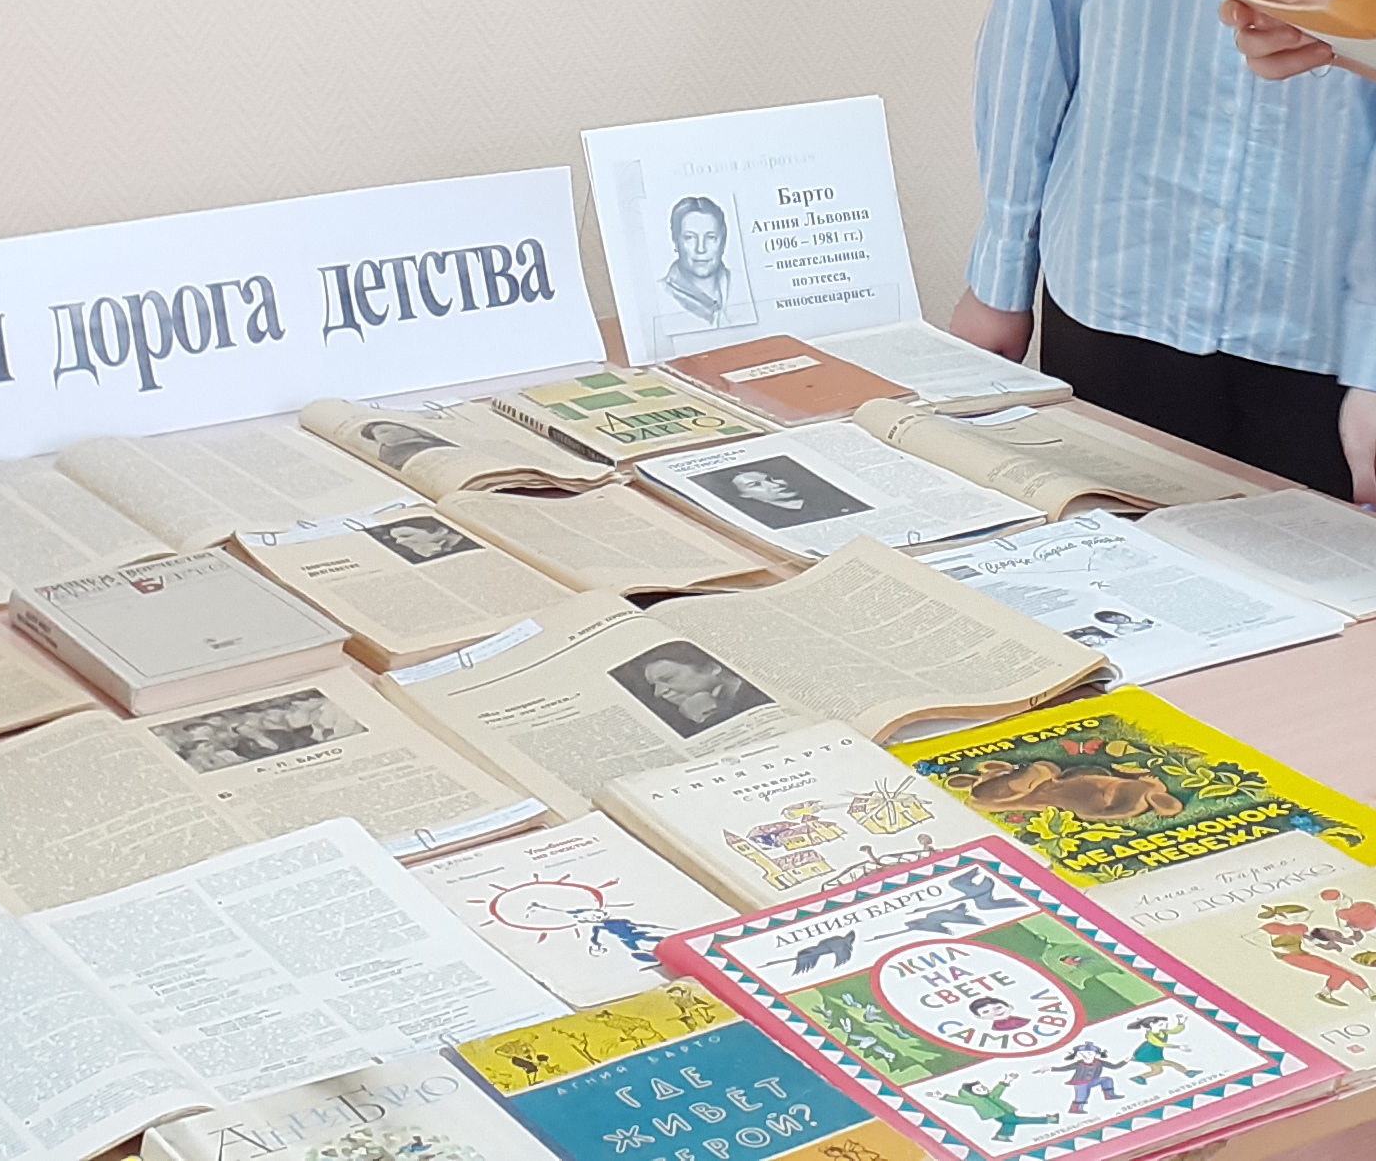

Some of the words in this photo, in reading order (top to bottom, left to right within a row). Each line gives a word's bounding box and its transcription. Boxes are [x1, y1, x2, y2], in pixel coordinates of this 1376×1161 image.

[777, 186, 835, 208] Барто
[750, 216, 800, 234] Агния
[803, 208, 870, 228] Львовна
[763, 235, 798, 254] (1906
[812, 231, 840, 247] 1981
[775, 249, 871, 271] писательница,
[775, 287, 876, 310] киносценарист.
[791, 271, 852, 288] поэтесса,
[47, 274, 286, 393] дорога
[317, 236, 556, 347] детства
[596, 415, 727, 445] БАРТО
[601, 405, 708, 433] АГНИЯ
[937, 737, 1015, 765] АГНИЯ
[1021, 716, 1101, 745] БАРТО
[650, 770, 748, 800] АГНИЯ
[761, 737, 853, 771] БАРТО
[1062, 802, 1294, 873] МЕДВЕЖОНОК-
[1137, 824, 1280, 867] НЕВЕЖА
[774, 909, 863, 950] АГНИЯ
[867, 883, 945, 930] БАРТО
[1134, 884, 1206, 910] Агния
[887, 946, 971, 978] ЖИЛ
[920, 965, 975, 988] НА
[919, 970, 1017, 1009] СВЕТЕ
[937, 988, 1069, 1050] САМОСВАЛ
[555, 1064, 629, 1097] АГНИЯ
[647, 1034, 722, 1065] БАРТО
[614, 1065, 714, 1110] ГДЕ
[602, 1076, 788, 1154] ЖИВЁТ
[651, 1103, 819, 1161] ЕРОЙ?
